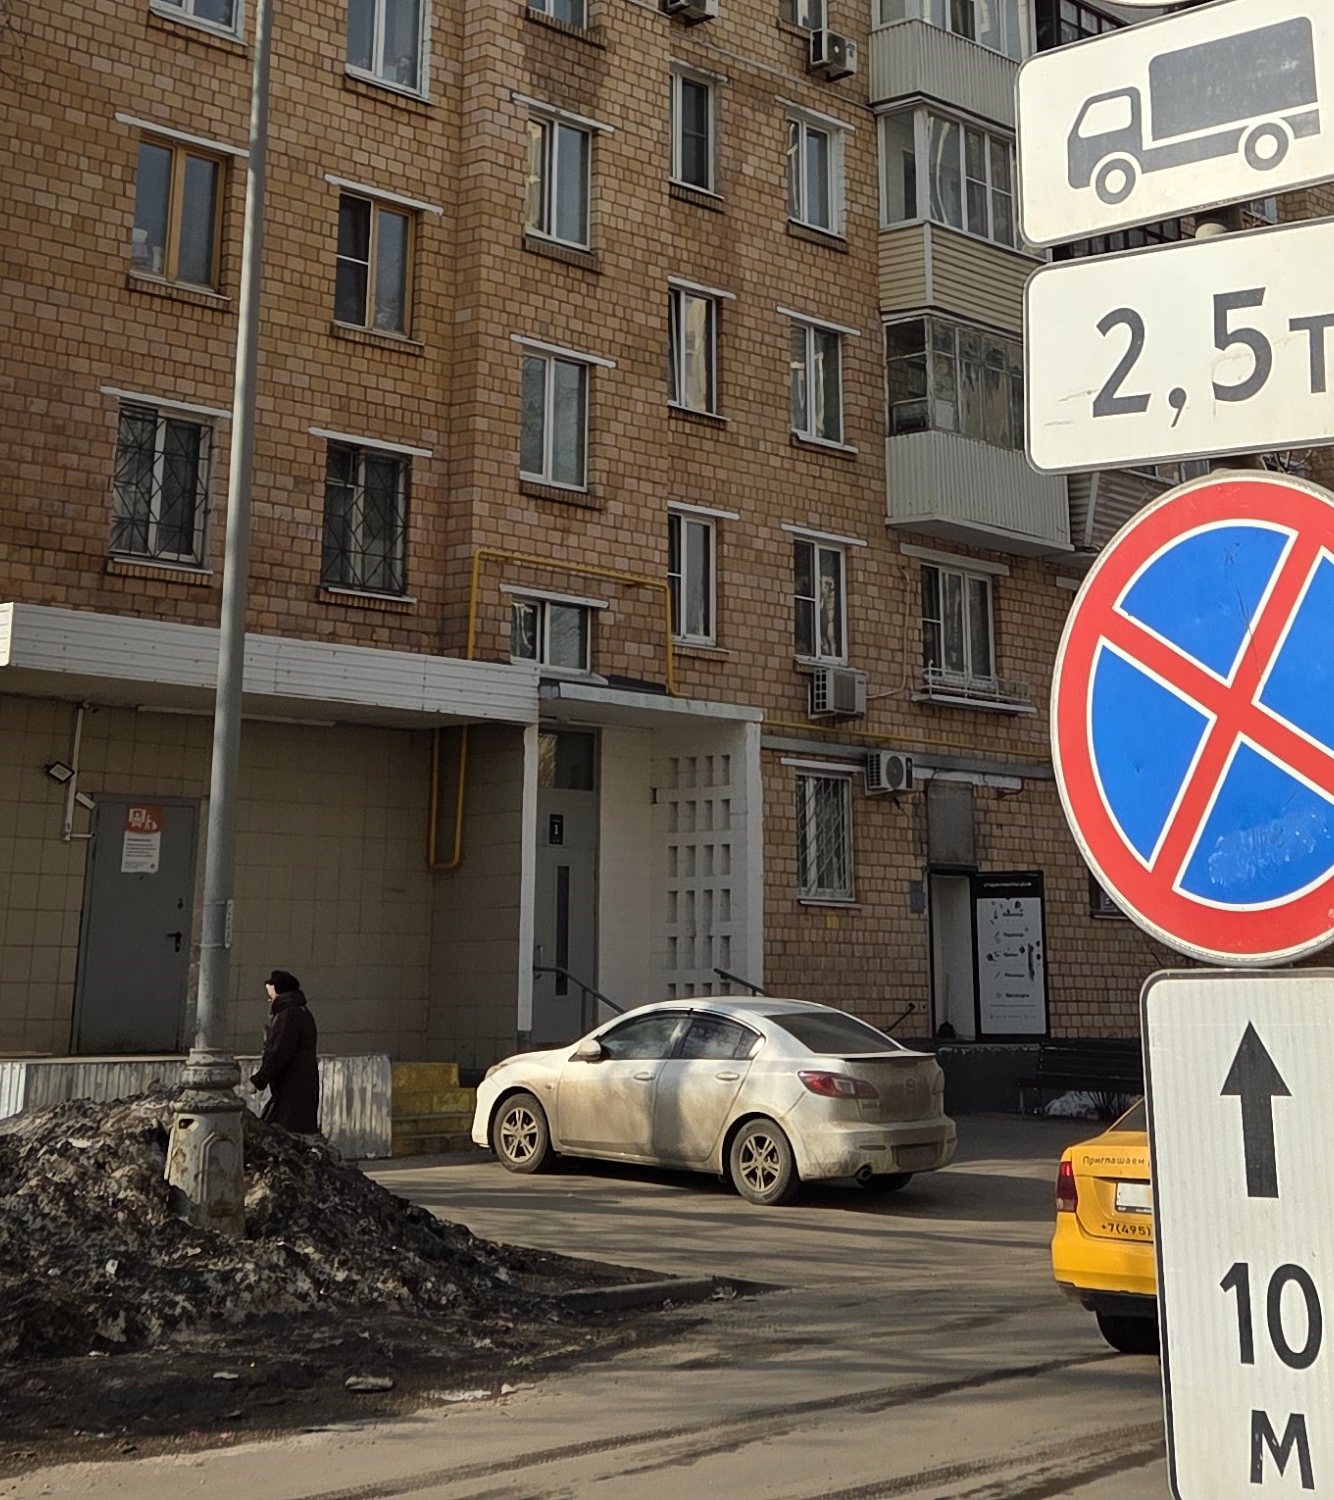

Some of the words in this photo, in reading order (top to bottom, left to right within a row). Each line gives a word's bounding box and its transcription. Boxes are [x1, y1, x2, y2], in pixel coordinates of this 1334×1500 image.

[1082, 1155, 1145, 1166] Приглашаем
[1101, 1222, 1151, 1237] +7(495)
[1219, 1262, 1323, 1370] 10
